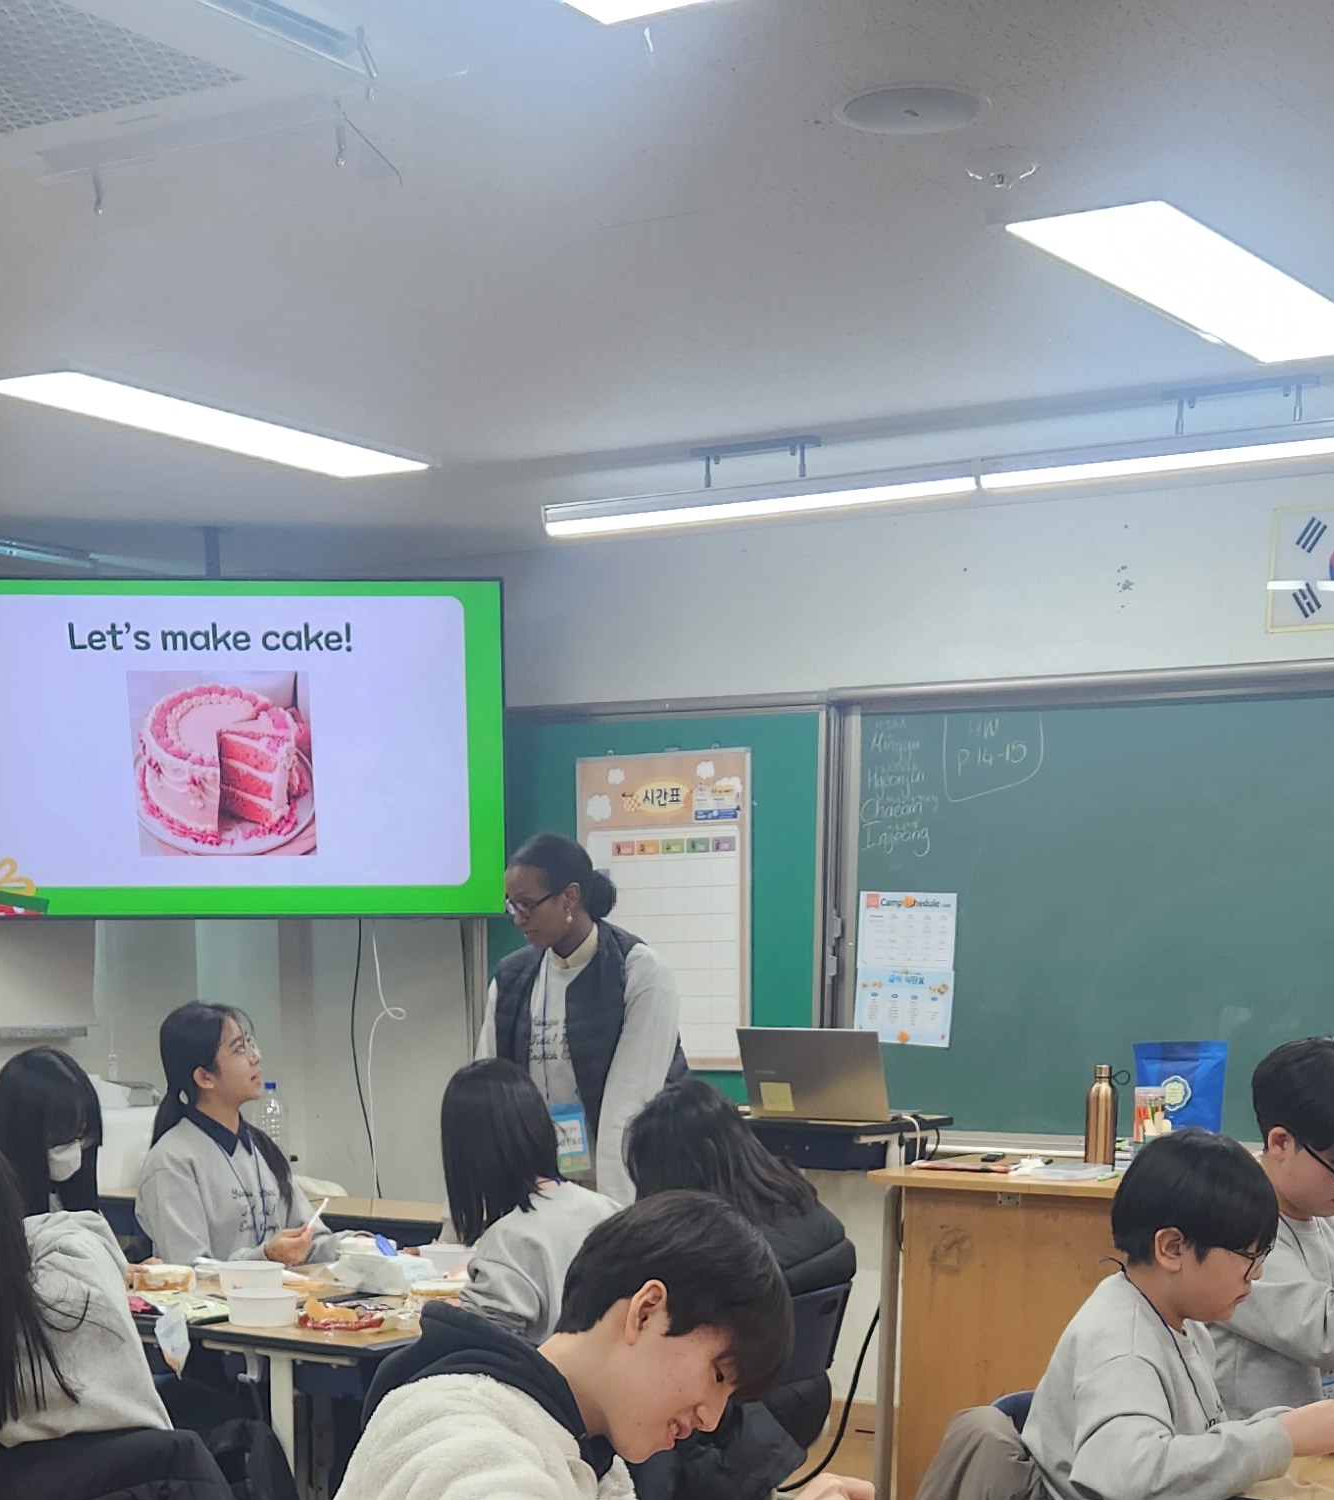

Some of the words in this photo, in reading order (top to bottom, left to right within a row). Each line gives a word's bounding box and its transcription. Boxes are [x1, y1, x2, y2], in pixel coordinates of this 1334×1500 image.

[160, 621, 252, 652] make
[261, 621, 353, 653] cake!
[642, 787, 681, 807] 시간표
[880, 898, 902, 908] Camp
